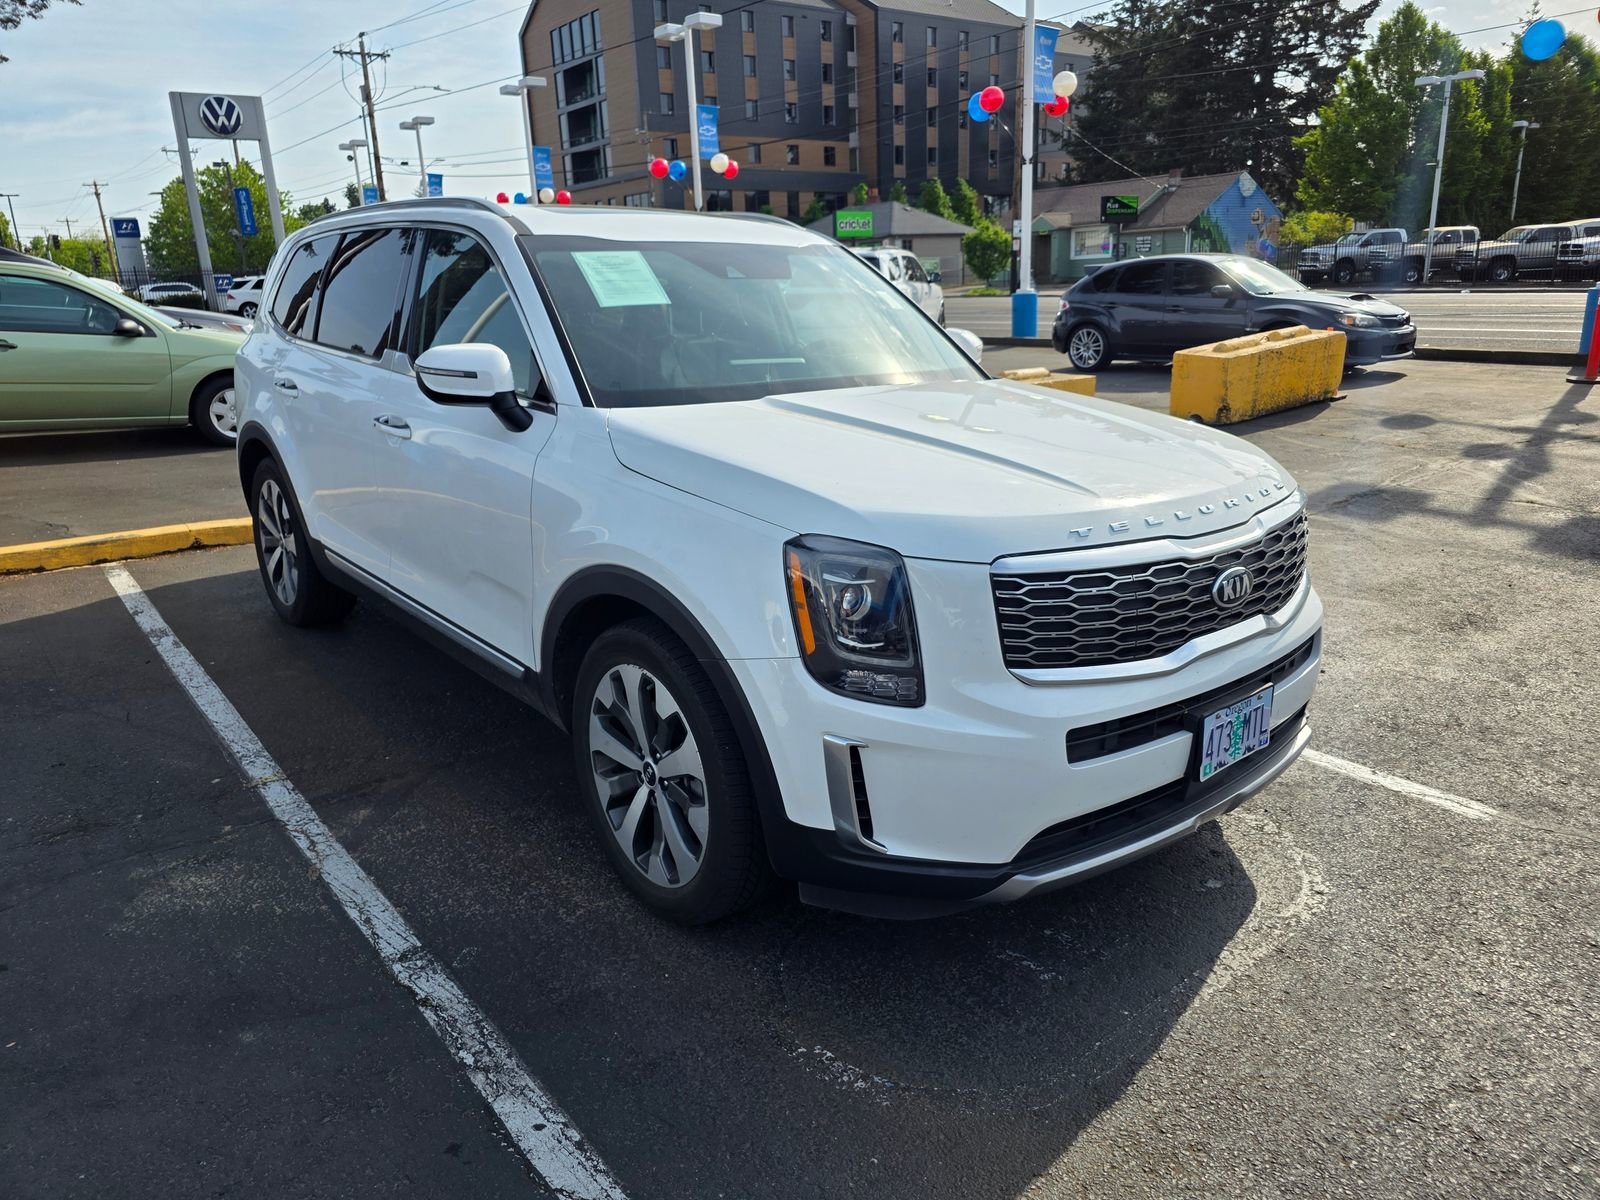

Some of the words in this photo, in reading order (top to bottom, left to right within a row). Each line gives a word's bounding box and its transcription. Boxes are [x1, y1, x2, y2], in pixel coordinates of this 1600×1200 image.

[201, 95, 242, 134] VW
[838, 217, 871, 230] cricket
[1069, 481, 1285, 537] TELLURIDE
[1222, 575, 1250, 602] KIA
[1225, 699, 1252, 716] Oregon
[1205, 719, 1233, 761] 473
[1241, 704, 1268, 744] MTL
